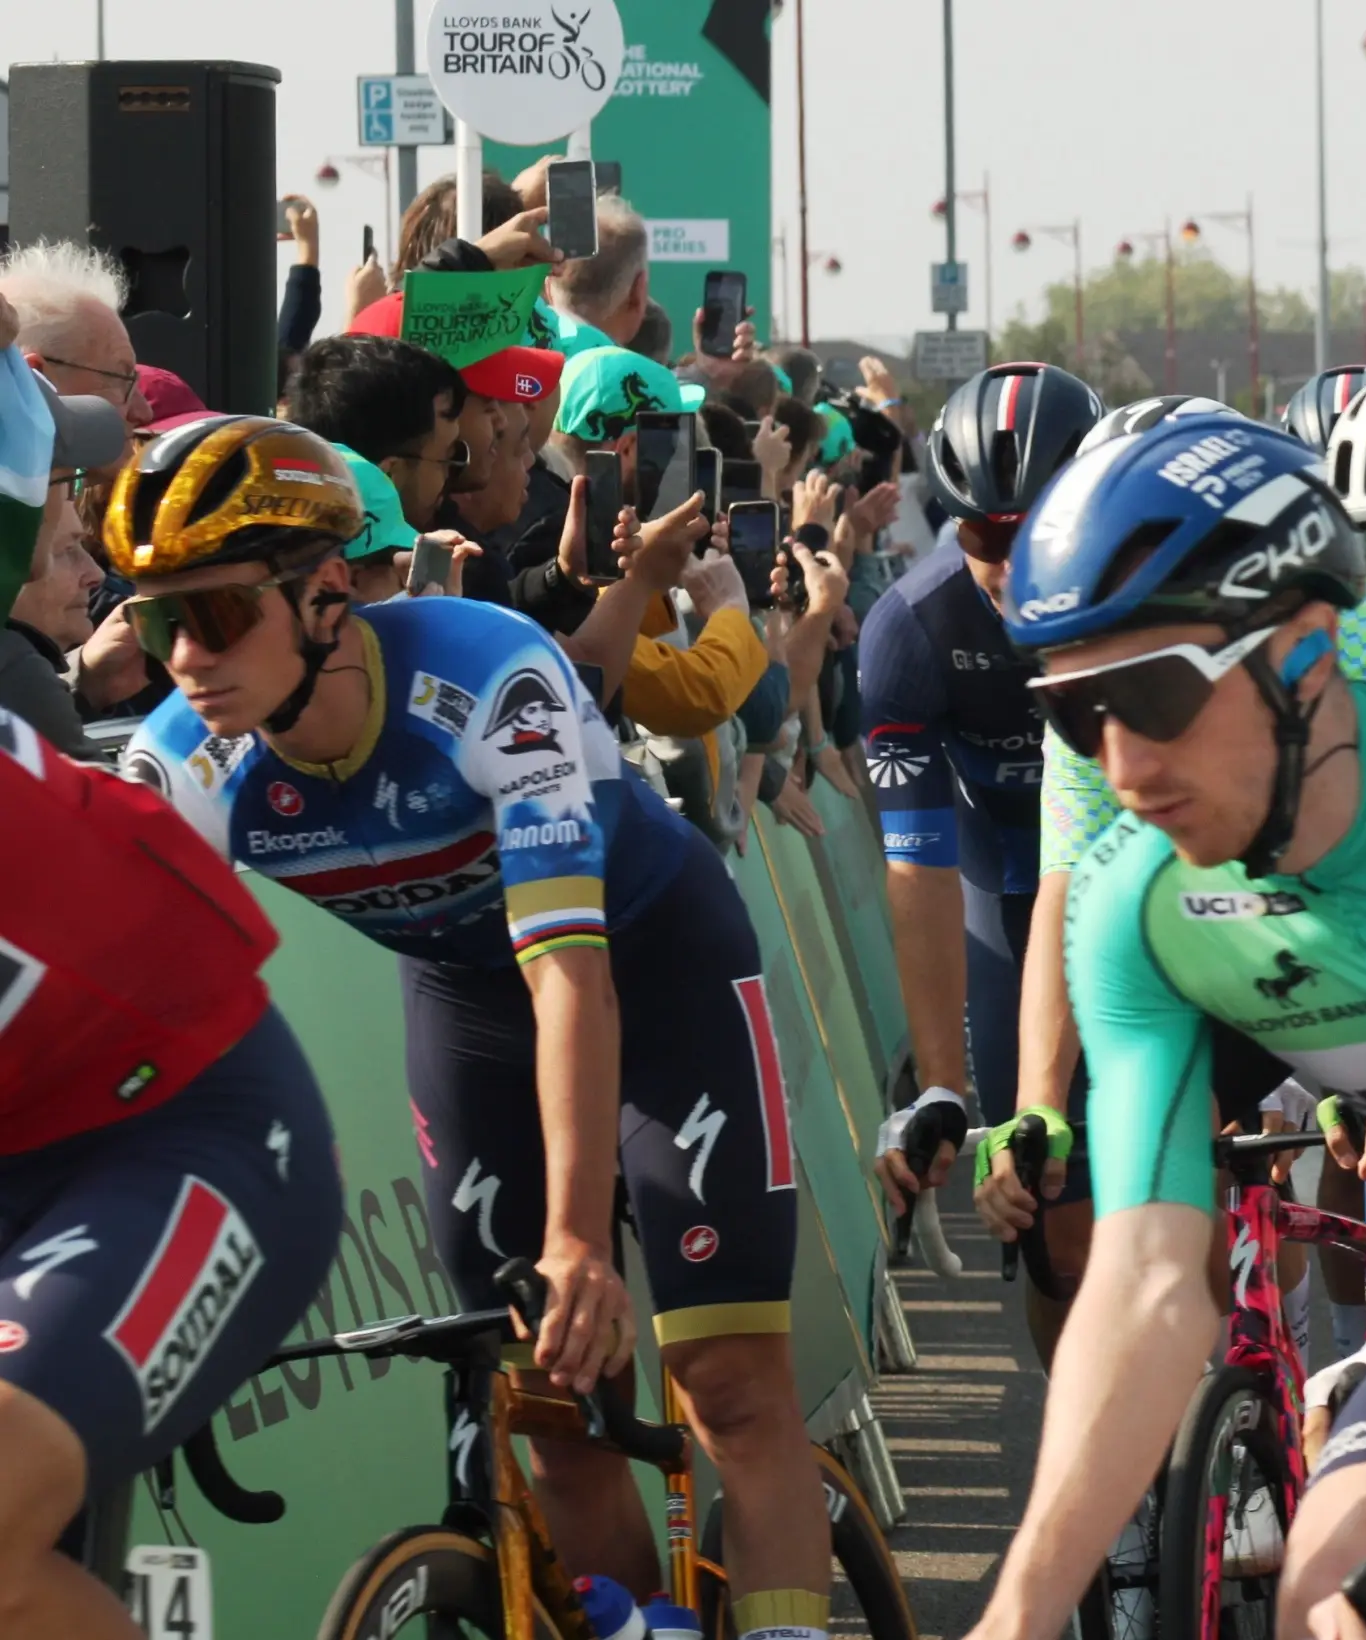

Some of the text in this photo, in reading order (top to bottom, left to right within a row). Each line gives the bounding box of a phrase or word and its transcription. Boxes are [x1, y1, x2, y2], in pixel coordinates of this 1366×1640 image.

[444, 16, 542, 29] LLOYDS BANK
[444, 32, 555, 53] TOUR OF
[624, 45, 647, 60] HE
[444, 53, 544, 74] BRITAIN
[620, 63, 703, 78] ATIONAL
[653, 227, 686, 240] PRO
[653, 240, 707, 254] SERIES
[410, 314, 468, 331] TOUR
[408, 325, 486, 348] BRITAIN
[247, 826, 349, 855] Ekopak
[1185, 896, 1237, 916] UCI
[146, 1231, 256, 1418] SOUDAL
